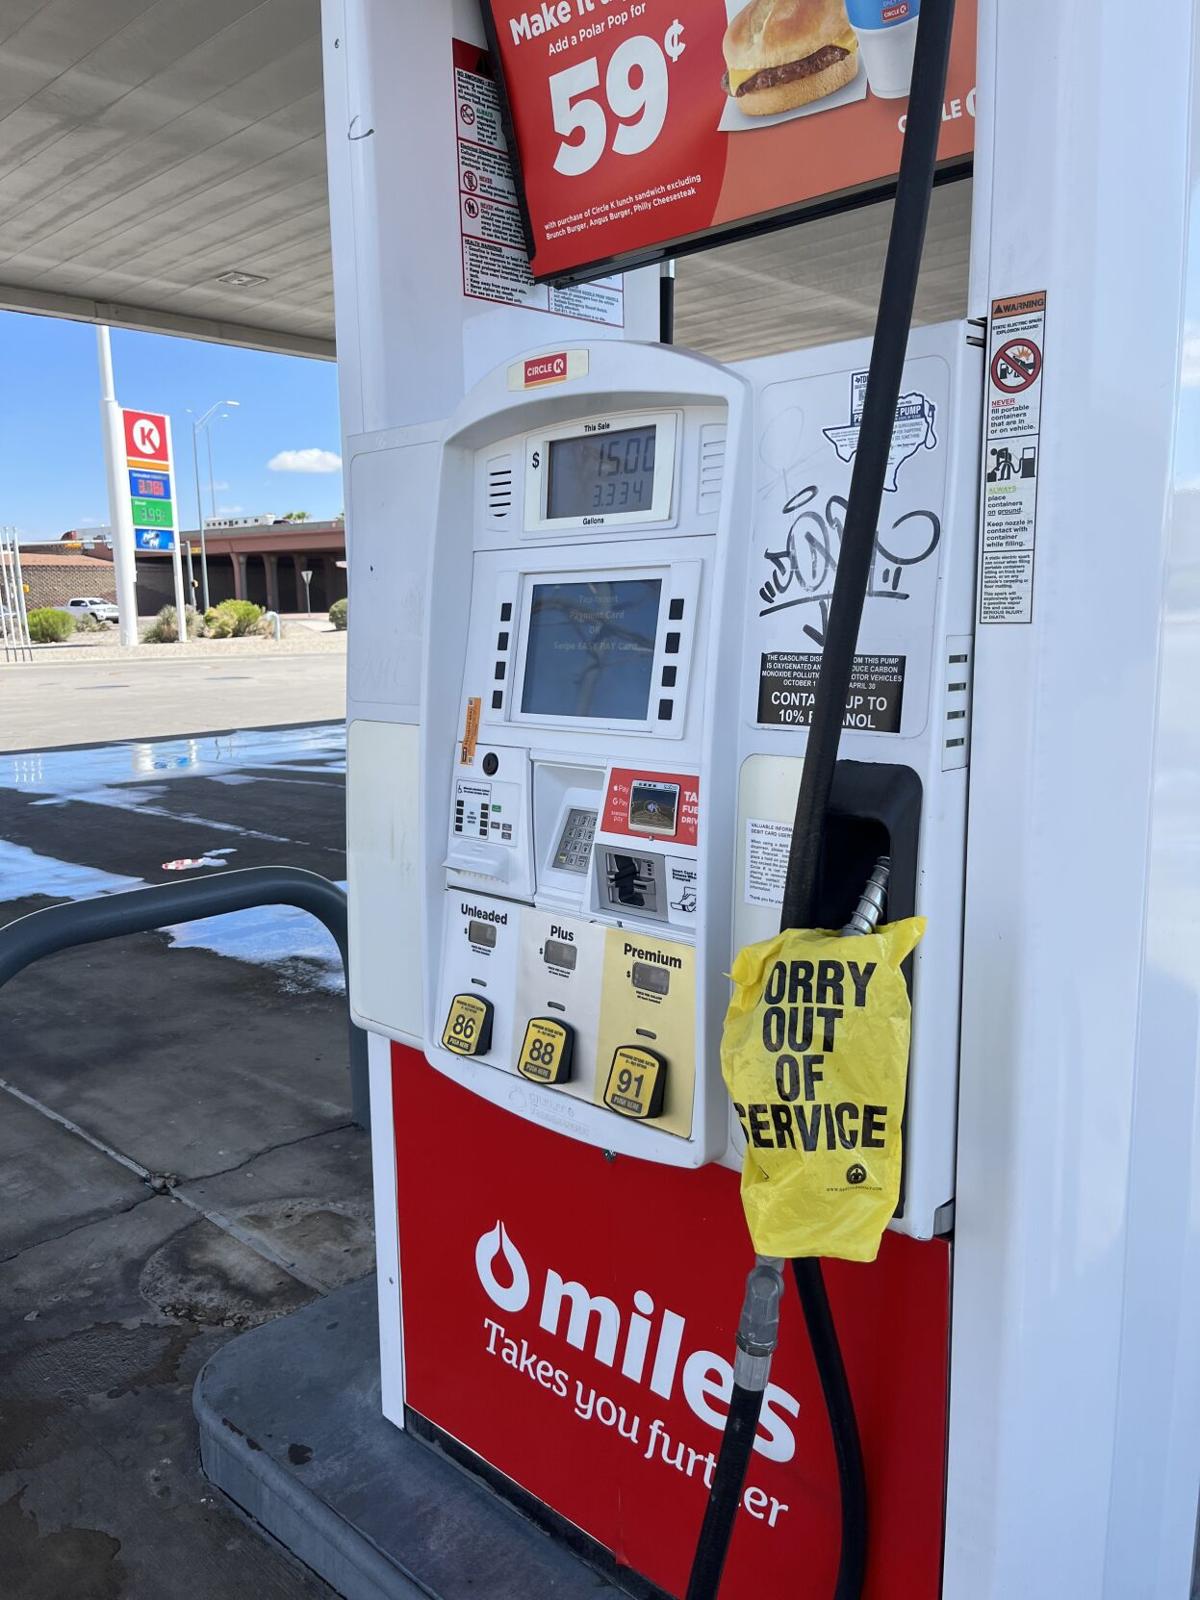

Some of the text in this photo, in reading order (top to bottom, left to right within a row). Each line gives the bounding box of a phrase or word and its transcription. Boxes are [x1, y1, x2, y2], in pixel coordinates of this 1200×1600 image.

[509, 1, 571, 45] Make
[549, 2, 646, 56] Add a Polar Pop for
[544, 174, 702, 230] with purchase of Circle K lunch sandwich excluding
[546, 186, 697, 241] Brunch Burger, Angus Burger, Philly Cheesesteak
[1003, 298, 1044, 313] WARNING
[527, 358, 564, 377] CIRCLE K
[900, 406, 921, 416] PUMP
[992, 398, 1015, 407] NEVER
[1001, 404, 1030, 414] portable
[991, 412, 1027, 421] containers
[584, 421, 610, 433] This Sale
[1010, 424, 1036, 432] vehicle.
[140, 427, 158, 451] K
[532, 451, 540, 470] $
[593, 480, 644, 507] 3.334
[583, 516, 604, 526] Gallons
[998, 507, 1023, 516] ground.
[773, 662, 811, 670] OXYGENATED
[880, 657, 899, 665] PUMP
[870, 674, 903, 682] VEHICLES
[771, 691, 816, 706] CONTA
[867, 696, 888, 711] TO
[779, 709, 805, 723] 10%
[618, 785, 629, 794] Pay
[684, 791, 698, 803] TA
[619, 799, 628, 807] Pay
[682, 805, 698, 815] FUE
[461, 903, 508, 926] Unleaded
[550, 924, 574, 942] Plus
[624, 942, 682, 969] Premium
[764, 959, 878, 1007] ORRY
[453, 1013, 476, 1039] 86
[762, 1006, 844, 1053] OUT
[529, 1038, 555, 1065] 88
[617, 1069, 644, 1098] 91
[775, 1054, 825, 1102] OF
[539, 1268, 801, 1463] miles
[484, 1317, 789, 1528] Takes you furter
